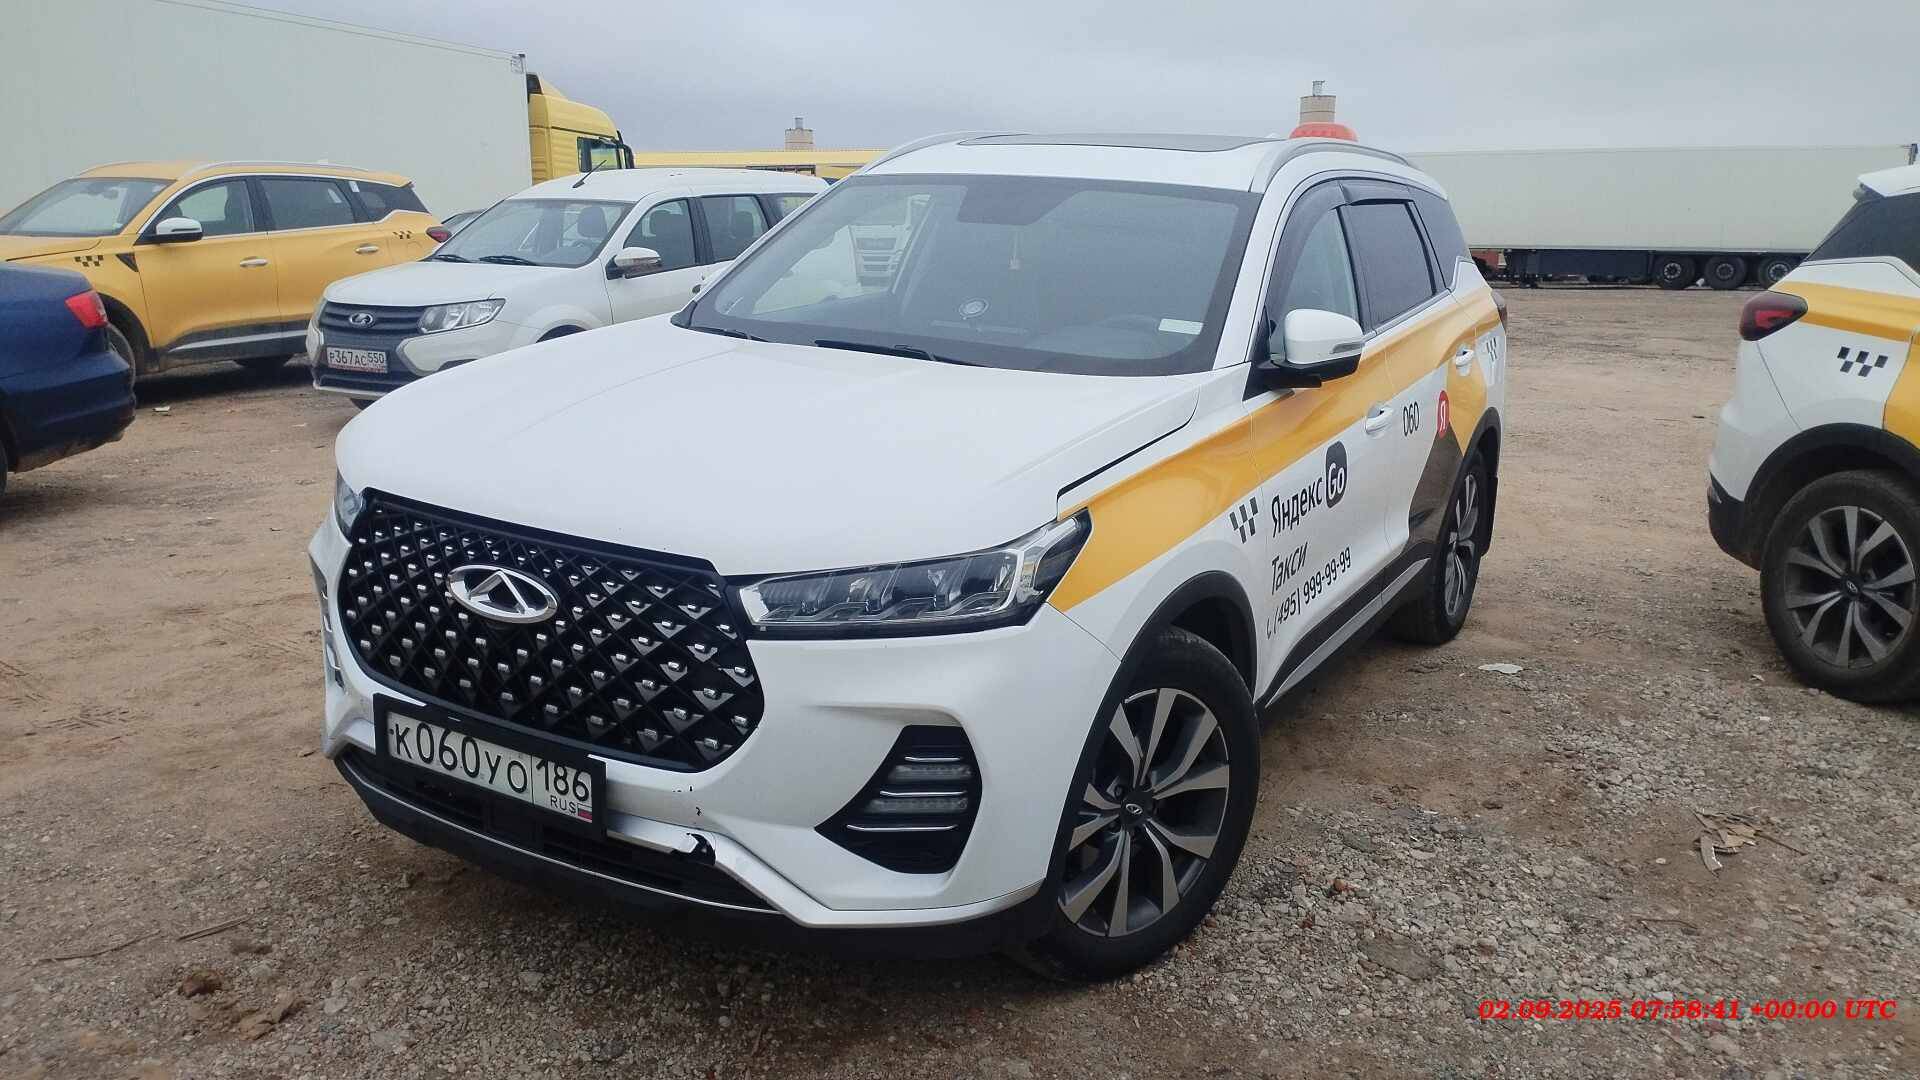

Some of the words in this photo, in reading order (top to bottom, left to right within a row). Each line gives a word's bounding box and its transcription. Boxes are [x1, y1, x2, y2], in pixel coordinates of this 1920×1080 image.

[367, 351, 385, 364] 550
[1403, 401, 1420, 437] 060
[1271, 477, 1323, 538] Яндекс
[1327, 461, 1345, 501] Go
[1271, 541, 1308, 596] Такси
[1303, 546, 1351, 605] 999-99-99
[395, 721, 528, 794] К060УО
[536, 757, 592, 802] 186
[549, 795, 577, 815] RUS
